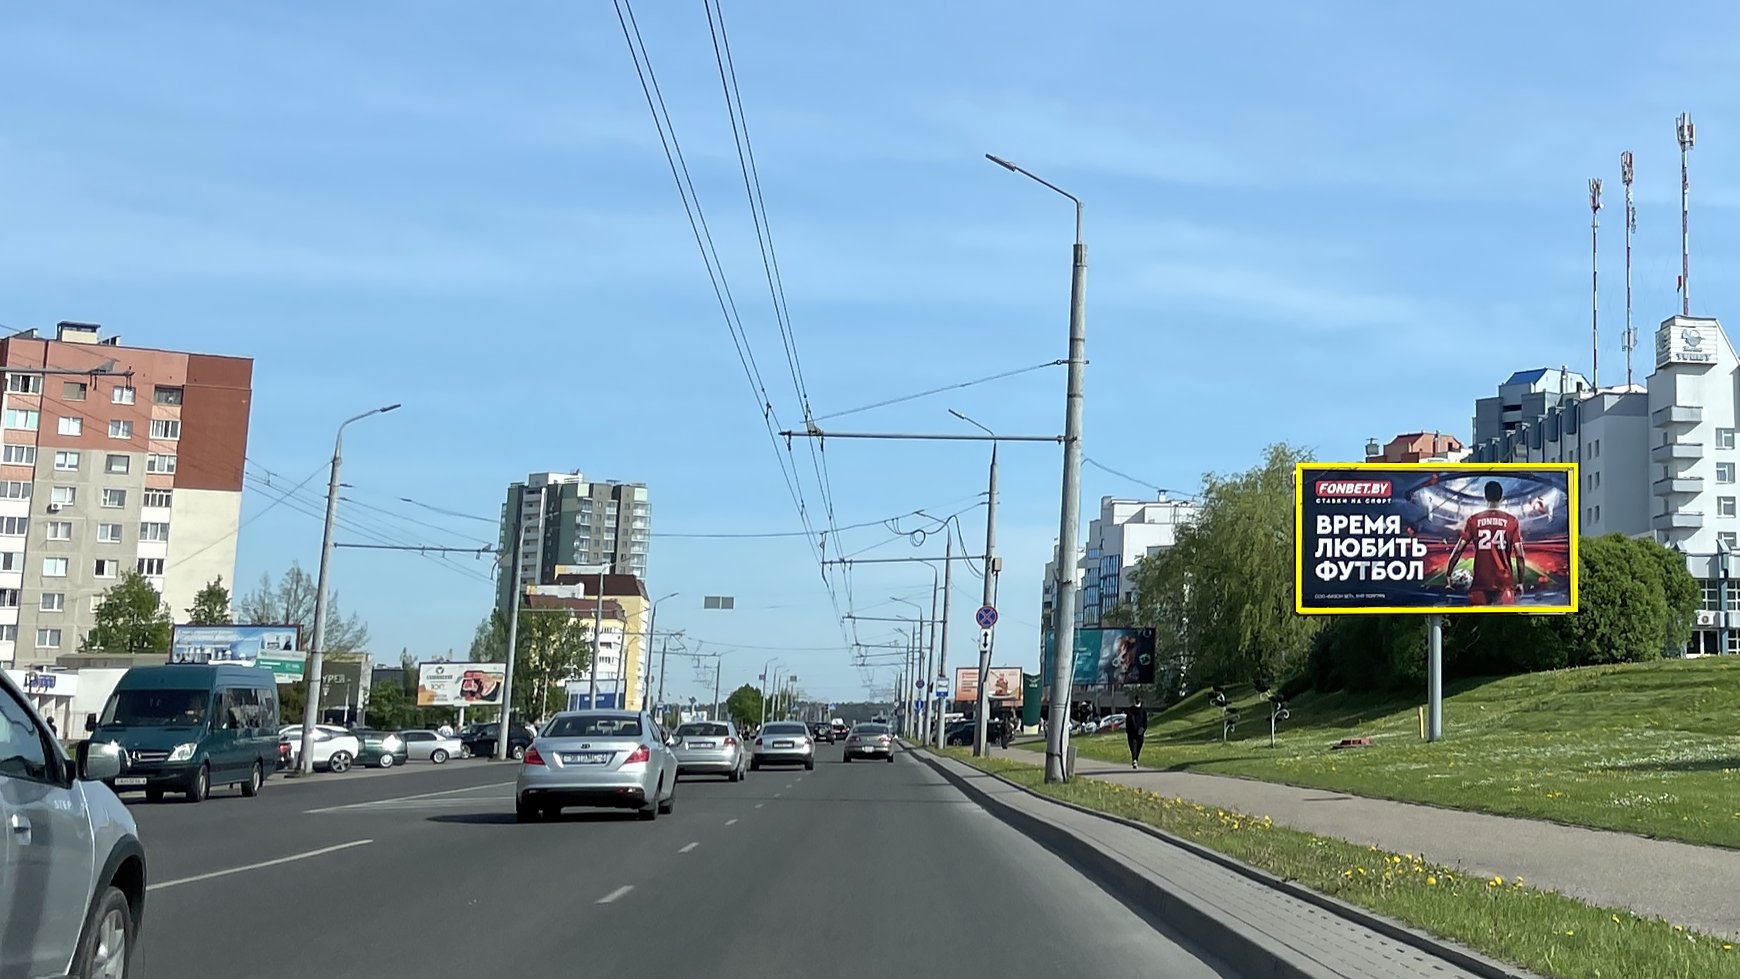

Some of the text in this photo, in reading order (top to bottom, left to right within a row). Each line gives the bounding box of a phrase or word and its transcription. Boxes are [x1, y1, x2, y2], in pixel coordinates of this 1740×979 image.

[1319, 483, 1388, 494] FONBET.BY
[1316, 514, 1401, 535] ВРЕМЯ
[1314, 537, 1428, 558] ЛЮБИТЬ
[1478, 529, 1507, 550] 24
[1314, 560, 1425, 581] ФУТБОЛ
